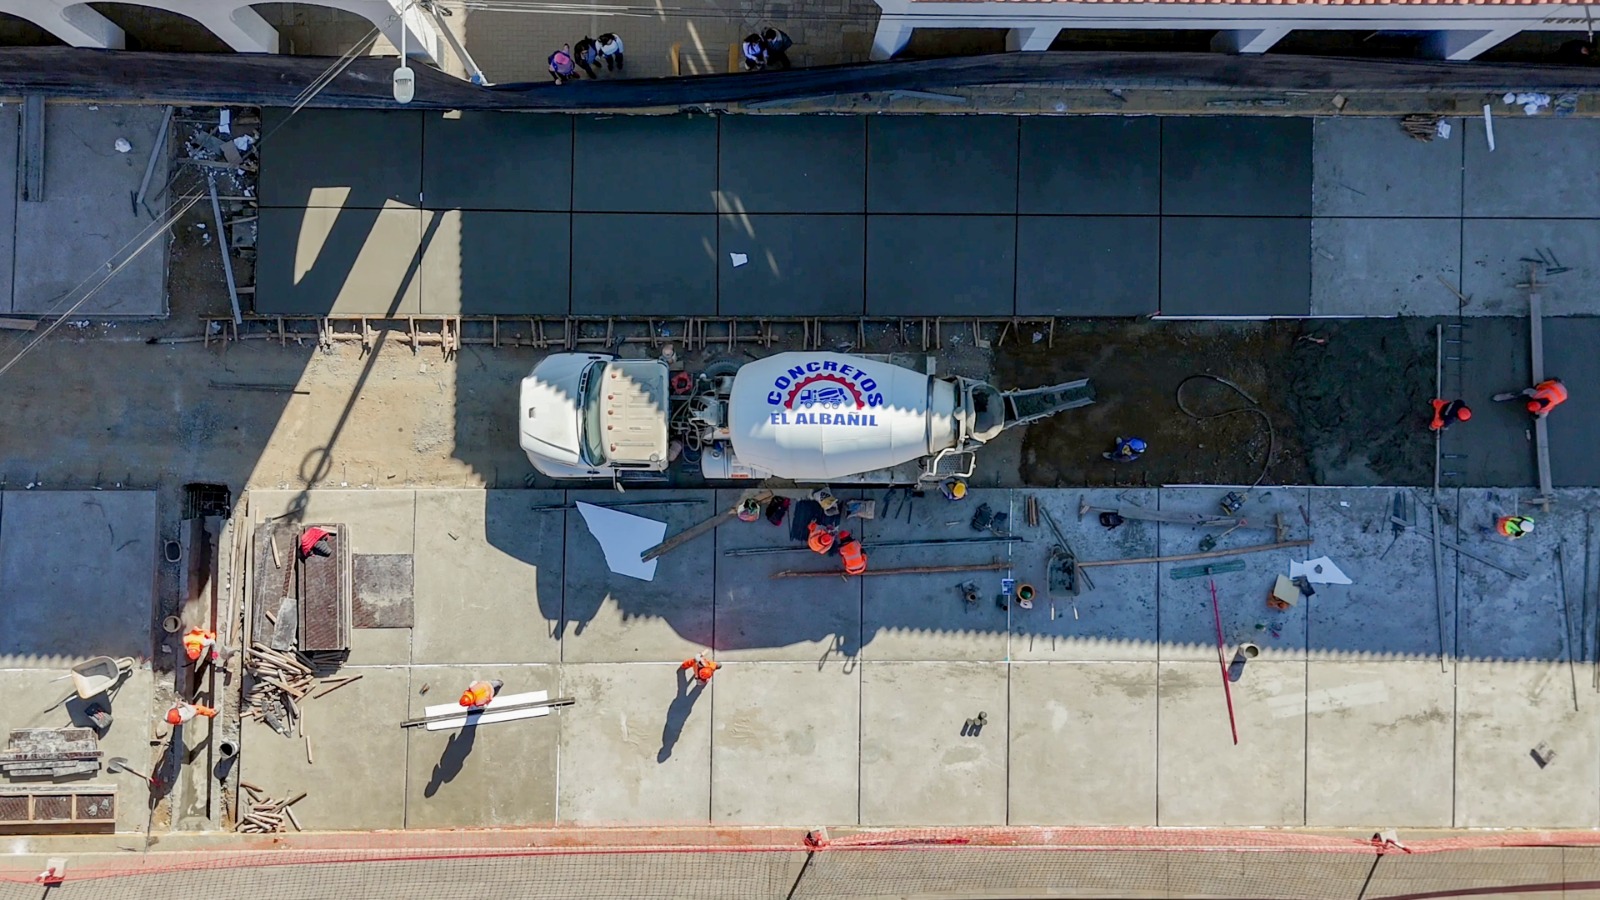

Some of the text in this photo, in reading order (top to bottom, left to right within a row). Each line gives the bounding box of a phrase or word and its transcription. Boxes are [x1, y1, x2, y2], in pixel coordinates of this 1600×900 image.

[767, 361, 883, 407] CONCRETOS
[770, 411, 879, 427] EL ALBAÑIL
